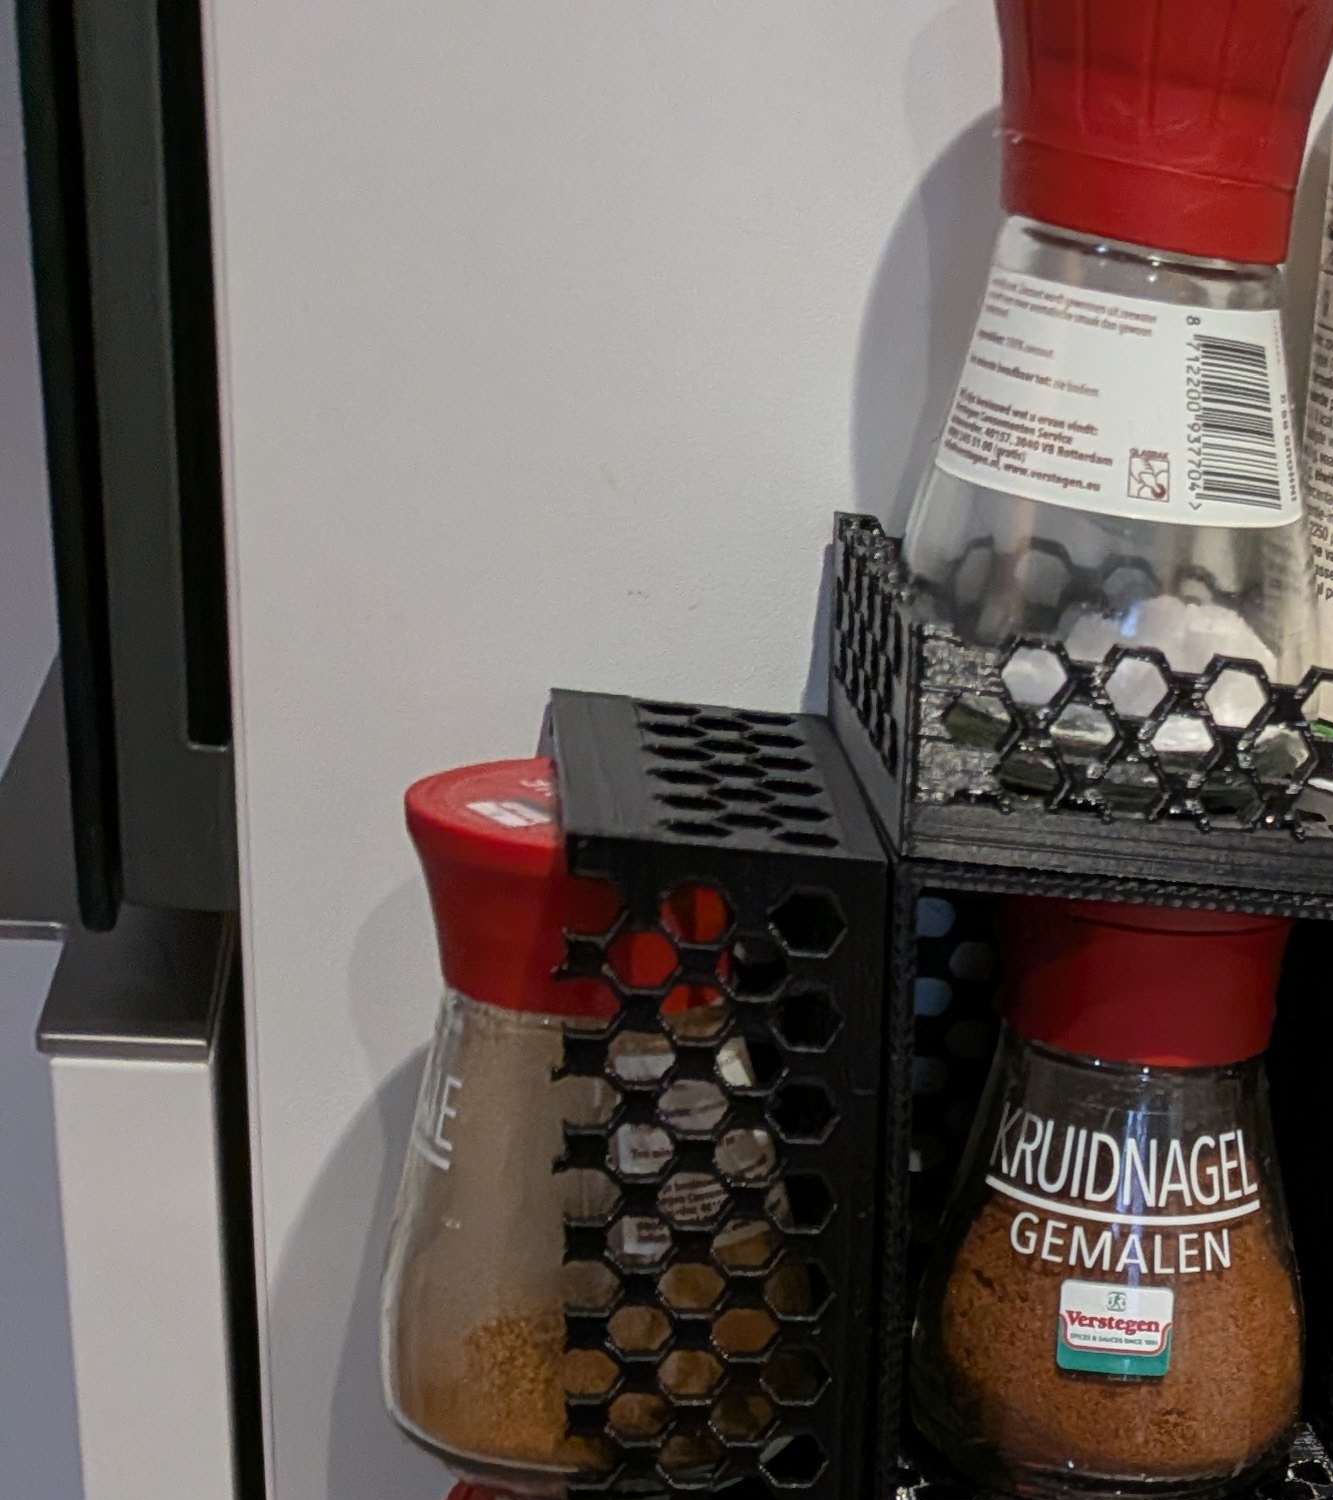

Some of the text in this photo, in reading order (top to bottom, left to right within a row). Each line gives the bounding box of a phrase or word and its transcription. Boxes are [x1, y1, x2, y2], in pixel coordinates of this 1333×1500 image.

[1185, 341, 1203, 493] 712200 937704
[1037, 427, 1073, 445] Service
[1057, 446, 1113, 467] Rotterdam
[1003, 462, 1102, 492] www.verstegen.eu
[989, 1102, 1259, 1209] KRUIDNAGEL
[1010, 1211, 1232, 1275] GEMALEN
[1065, 1309, 1160, 1336] Verstegen
